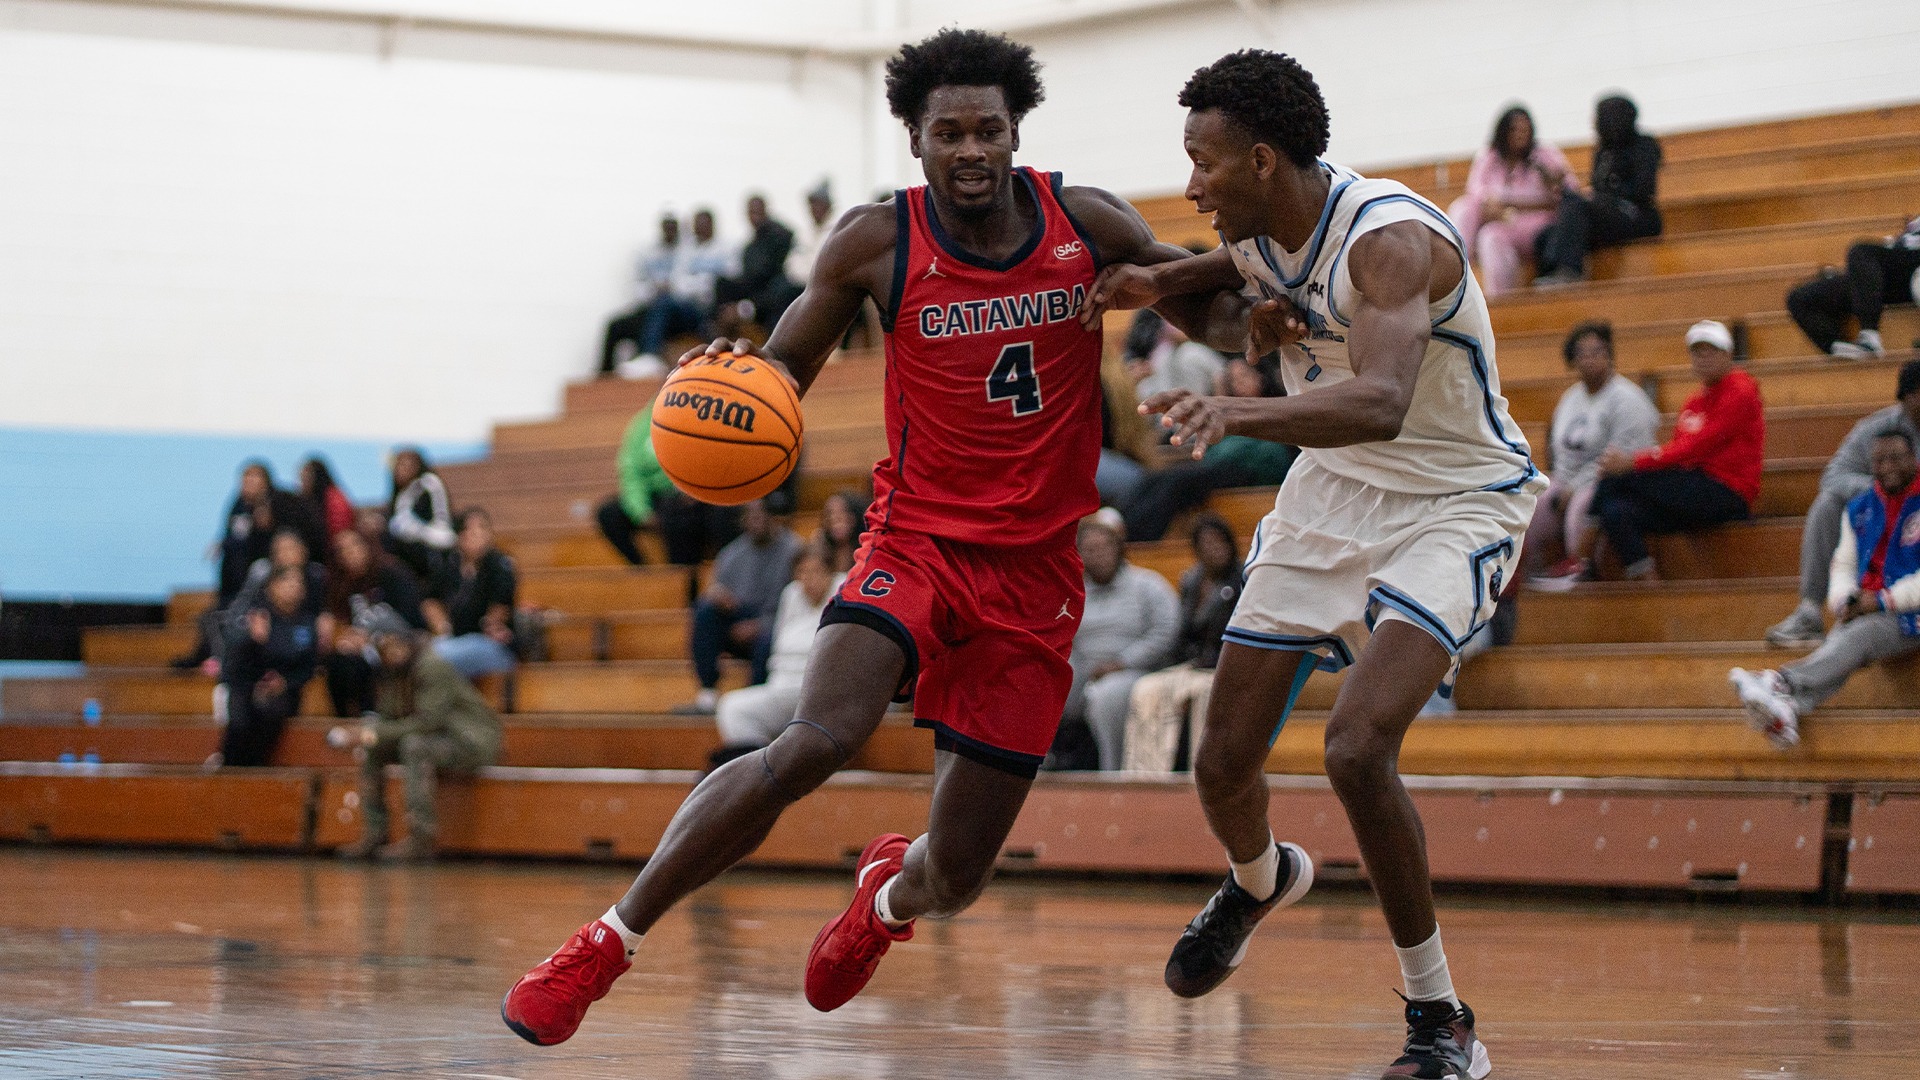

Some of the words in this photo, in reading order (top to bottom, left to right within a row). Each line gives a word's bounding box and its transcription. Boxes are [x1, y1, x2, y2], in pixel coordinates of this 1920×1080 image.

[1056, 240, 1082, 258] SAC
[919, 283, 1086, 339] CATAWBA
[986, 341, 1043, 418] 4
[663, 390, 756, 433] Wilson
[859, 568, 896, 598] C
